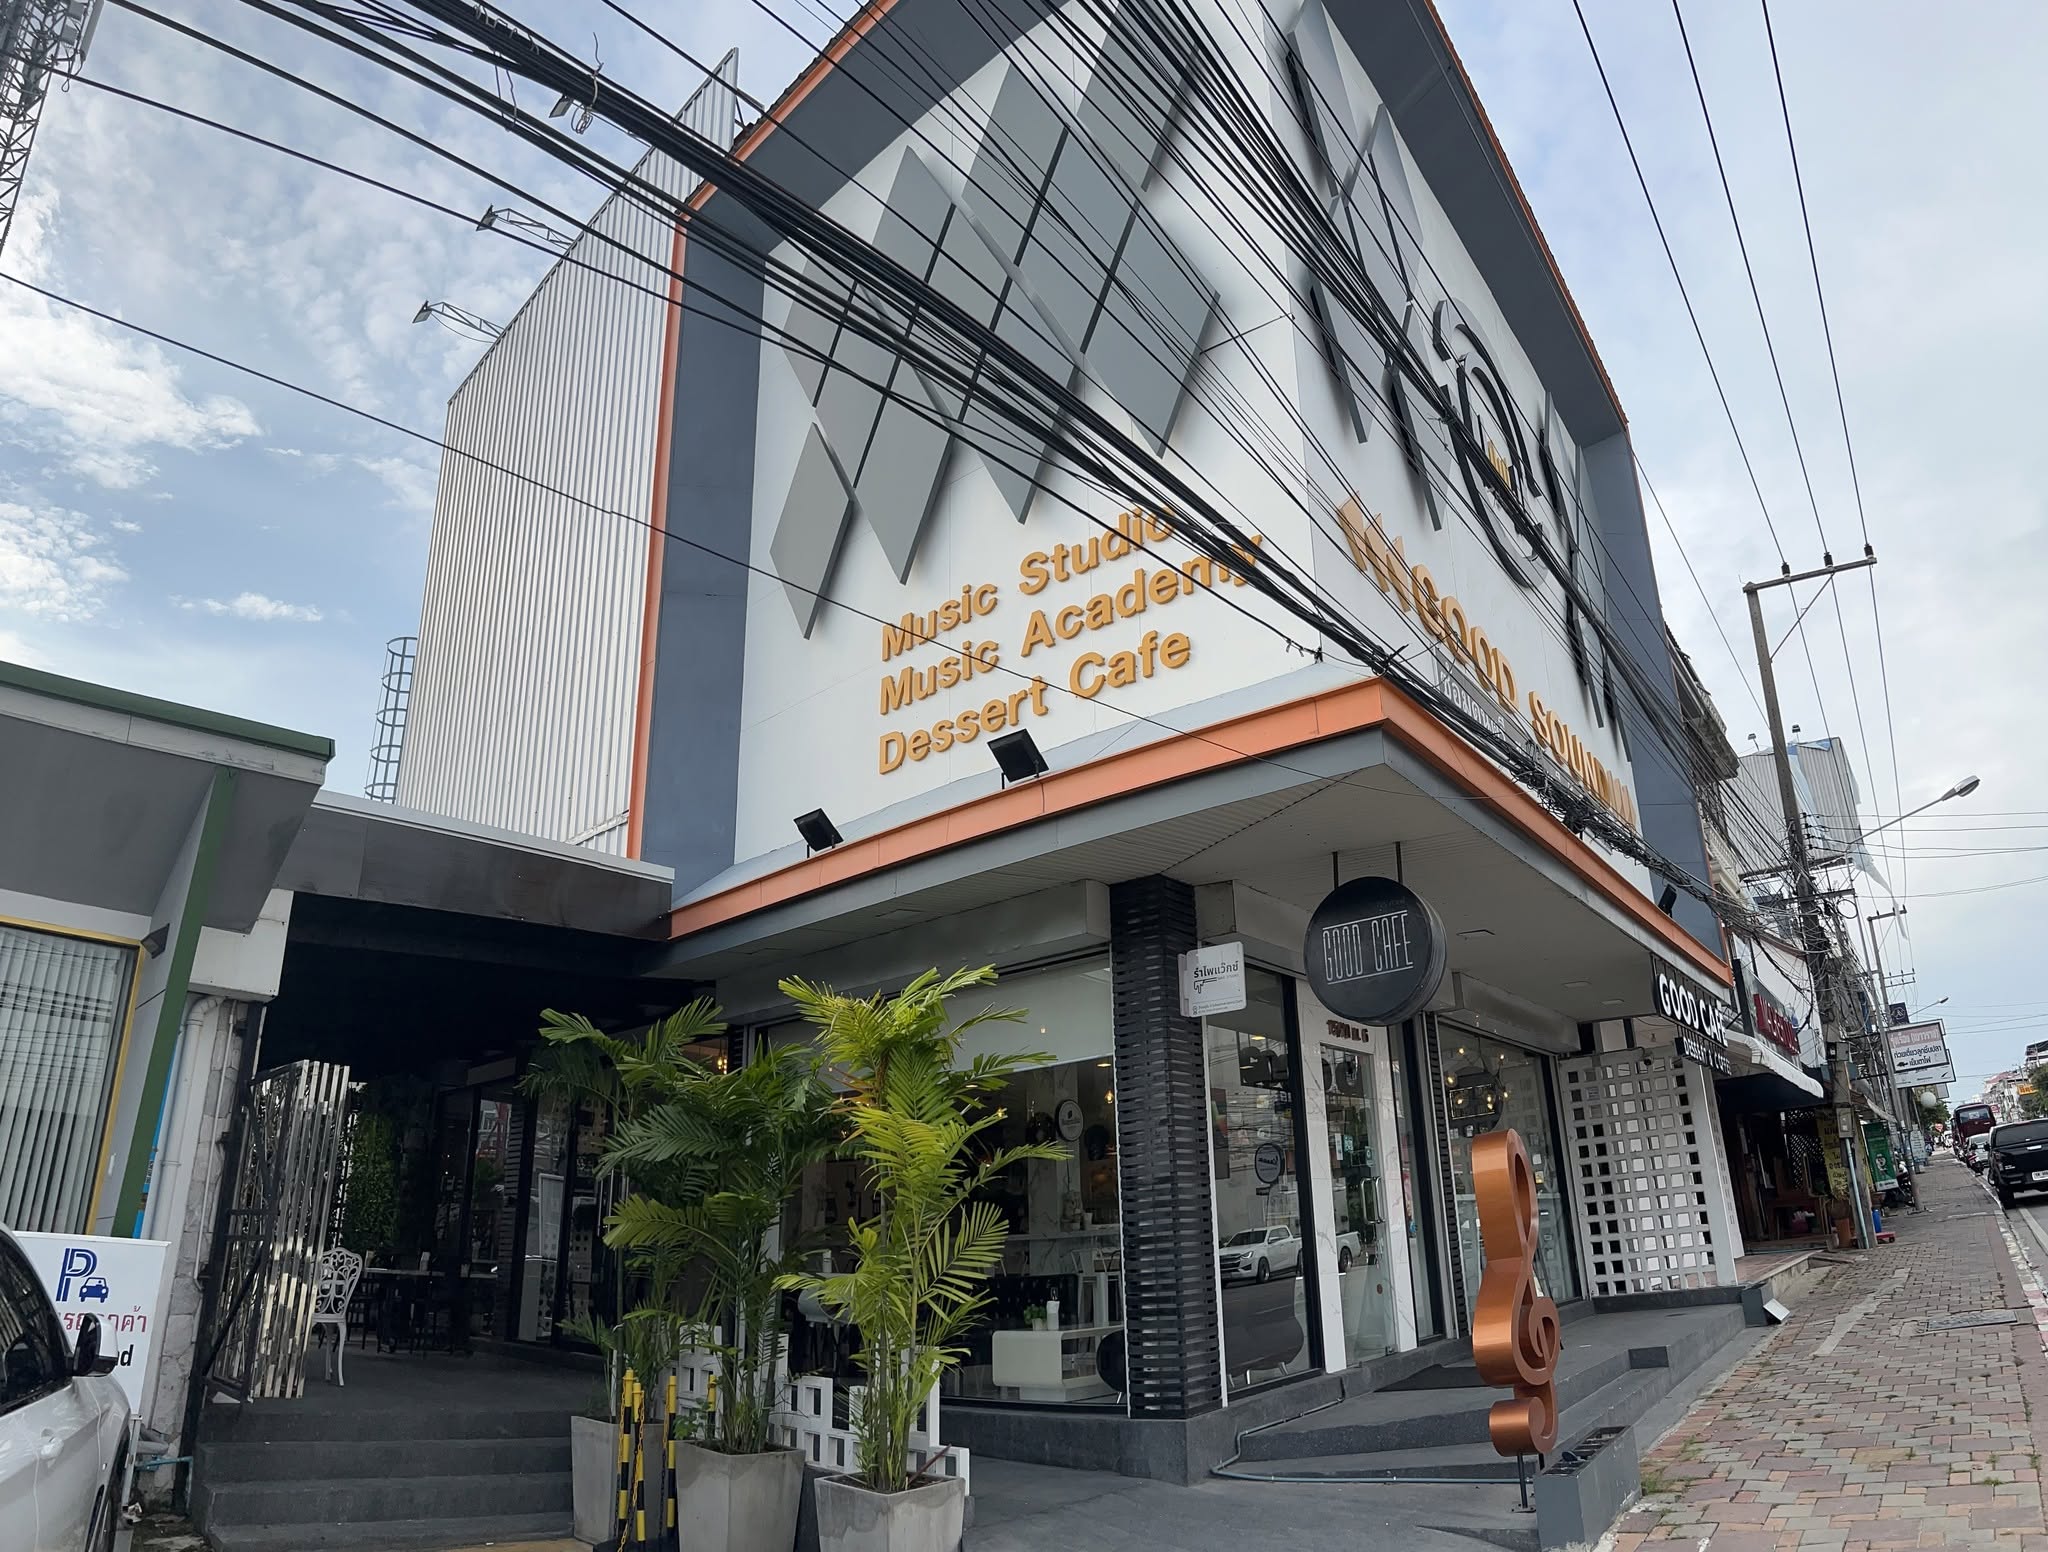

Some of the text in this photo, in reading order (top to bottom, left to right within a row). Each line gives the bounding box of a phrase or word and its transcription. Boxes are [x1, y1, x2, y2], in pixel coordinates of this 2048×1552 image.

[880, 534, 1263, 715] Music Academy
[881, 504, 1178, 662] Music Studio
[879, 630, 1192, 775] Dessert Cafe
[1322, 913, 1413, 982] GOOD CAFE
[1659, 974, 1698, 1030] GOOD
[1700, 999, 1727, 1047] CAFE
